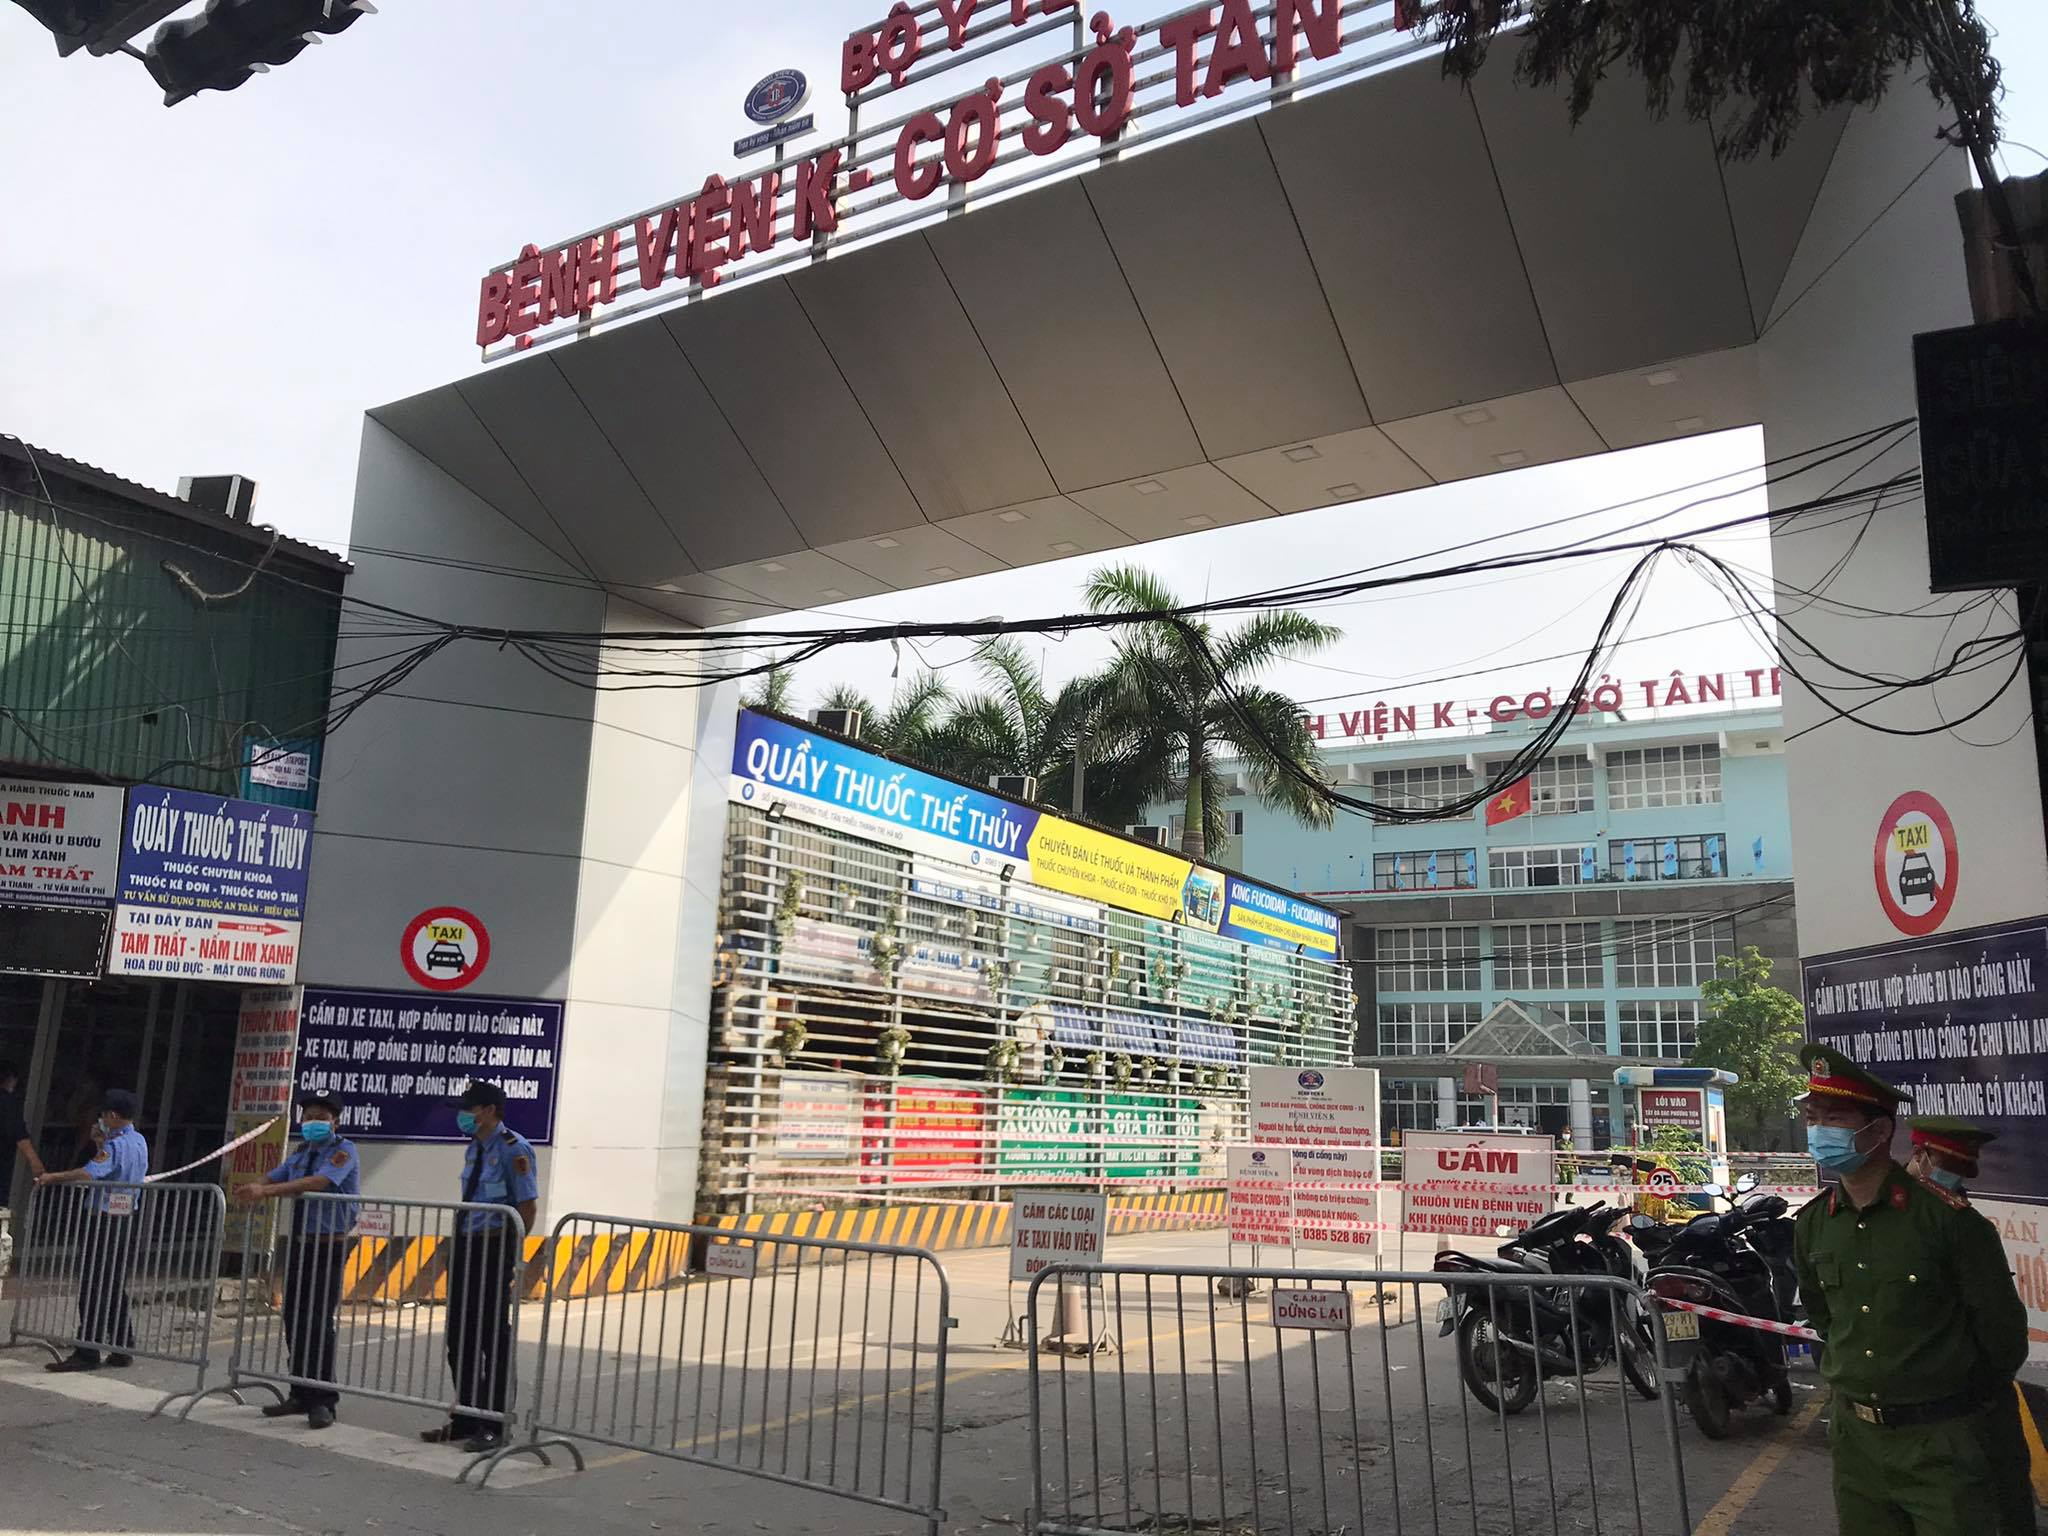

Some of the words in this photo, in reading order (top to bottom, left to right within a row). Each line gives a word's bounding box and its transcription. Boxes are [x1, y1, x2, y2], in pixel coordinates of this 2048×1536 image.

[842, 3, 922, 94] BỘ
[476, 243, 620, 351] BỆNH
[634, 173, 779, 289] VIỆN
[792, 149, 843, 241] K
[894, 77, 1004, 200] CƠ
[1022, 10, 1137, 156] SỞ
[1340, 700, 1416, 741] VIỆN
[1433, 701, 1456, 728] K
[1488, 687, 1553, 723] CƠ
[1640, 669, 1725, 708] TÂN
[746, 738, 828, 792] QUẦY
[834, 764, 914, 821] THUỐC
[920, 794, 968, 835] THẾ
[968, 806, 1023, 852] THỦY
[22, 830, 51, 844] KHỐI
[55, 835, 63, 845] U
[132, 792, 180, 854] QUẦY
[182, 801, 234, 862] THUỐC
[237, 810, 269, 866] THẾ
[269, 813, 308, 870] THỦY
[1898, 824, 1928, 848] TAXI
[5, 847, 28, 858] LIM
[32, 849, 66, 862] XANH
[1040, 836, 1072, 856] CHUYÊN
[1100, 854, 1124, 874] THUỐC
[32, 864, 94, 881] THẤT
[163, 861, 200, 875] THUỐC
[202, 866, 242, 880] CHUYÊN
[244, 871, 272, 884] KHOA
[130, 874, 166, 888] THUỐC
[186, 879, 210, 893] ĐƠN
[220, 884, 254, 898] THUỐC
[1232, 882, 1250, 904] KING
[1250, 888, 1288, 915] FUCOIDAN
[1290, 903, 1324, 928] FUCOIDAN
[129, 912, 150, 925] TẠI
[154, 912, 181, 926] ĐÂY
[432, 925, 462, 940] TAXI
[121, 932, 149, 955] TAM
[154, 928, 188, 958] THẤT
[199, 932, 230, 960] NẤM
[234, 940, 256, 962] LIM
[260, 942, 294, 966] XANH
[124, 958, 146, 970] HOA
[236, 966, 258, 978] ONG
[1815, 977, 1835, 1016] CẤM
[1847, 984, 1858, 1012] XE
[1859, 980, 1884, 1013] TAXI,
[1884, 976, 1904, 1014] HỢP
[1905, 964, 1934, 1006] ĐỒNG
[1936, 971, 1947, 1004] ĐI
[1948, 960, 1971, 1001] VÀO
[1973, 951, 2004, 998] CỔNG
[273, 1008, 297, 1032] NAM
[308, 1000, 334, 1026] CẤM
[337, 1009, 350, 1026] ĐI
[351, 1010, 367, 1026] XE
[369, 1010, 395, 1031] TAXI,
[398, 1010, 420, 1033] HỢP
[422, 1006, 452, 1034] ĐỒNG
[454, 1014, 467, 1032] ĐI
[468, 1010, 488, 1033] VÀO
[492, 1008, 520, 1035] CỔNG
[304, 1038, 321, 1057] XE
[322, 1040, 350, 1062] TAXI,
[352, 1040, 376, 1065] HỢP
[377, 1036, 408, 1062] ĐỒNG
[410, 1044, 422, 1062] ĐI
[424, 1040, 446, 1064] VÀO
[448, 1040, 477, 1065] CỔNG
[478, 1047, 486, 1065] 2
[488, 1047, 510, 1066] CHU
[512, 1046, 534, 1068] VĂN
[1854, 1030, 1873, 1070] HỢP
[1874, 1022, 1902, 1062] ĐỒNG
[1902, 1030, 1914, 1061] ĐI
[1914, 1022, 1936, 1061] VÀO
[1938, 1013, 1968, 1058] CỔNG
[1970, 1028, 1978, 1056] 2
[1980, 1024, 2002, 1056] CHU
[2004, 1014, 2030, 1055] VĂN
[300, 1066, 328, 1092] CẤM
[329, 1074, 342, 1092] ĐI
[343, 1074, 359, 1092] XE
[360, 1074, 388, 1096] TAXI,
[391, 1075, 414, 1099] HỢP
[416, 1069, 446, 1096] ĐỒNG
[504, 1076, 539, 1099] KHÁCH
[1916, 1073, 1944, 1115] ĐỒNG
[1948, 1077, 1984, 1116] KHÔNG
[1986, 1074, 2000, 1114] CÓ
[2004, 1074, 2048, 1116] KHÁCH
[354, 1103, 382, 1130] VIỆN.
[1438, 1140, 1519, 1174] CẤM
[1653, 1175, 1672, 1185] 25
[1264, 1193, 1290, 1206] COVID-19
[1412, 1194, 1450, 1208] KHUÔN
[1454, 1195, 1478, 1210] VIÊN
[1482, 1197, 1513, 1213] BỆNH
[1516, 1200, 1544, 1216] VIỆN
[1048, 1203, 1068, 1220] CÁC
[1070, 1206, 1095, 1224] LOẠI
[1296, 1208, 1320, 1219] ĐƯỜNG
[1408, 1213, 1427, 1224] KHI
[1430, 1212, 1468, 1226] KHÔNG
[1472, 1214, 1487, 1227] CÓ
[1016, 1229, 1030, 1248] XE
[1032, 1230, 1051, 1249] TAXI
[1053, 1228, 1072, 1250] VÀO
[1074, 1229, 1097, 1256] VIỆN
[1303, 1228, 1328, 1240] 0385
[1331, 1229, 1350, 1242] 528
[1352, 1230, 1372, 1244] 867
[1320, 1308, 1343, 1322] LẠI
